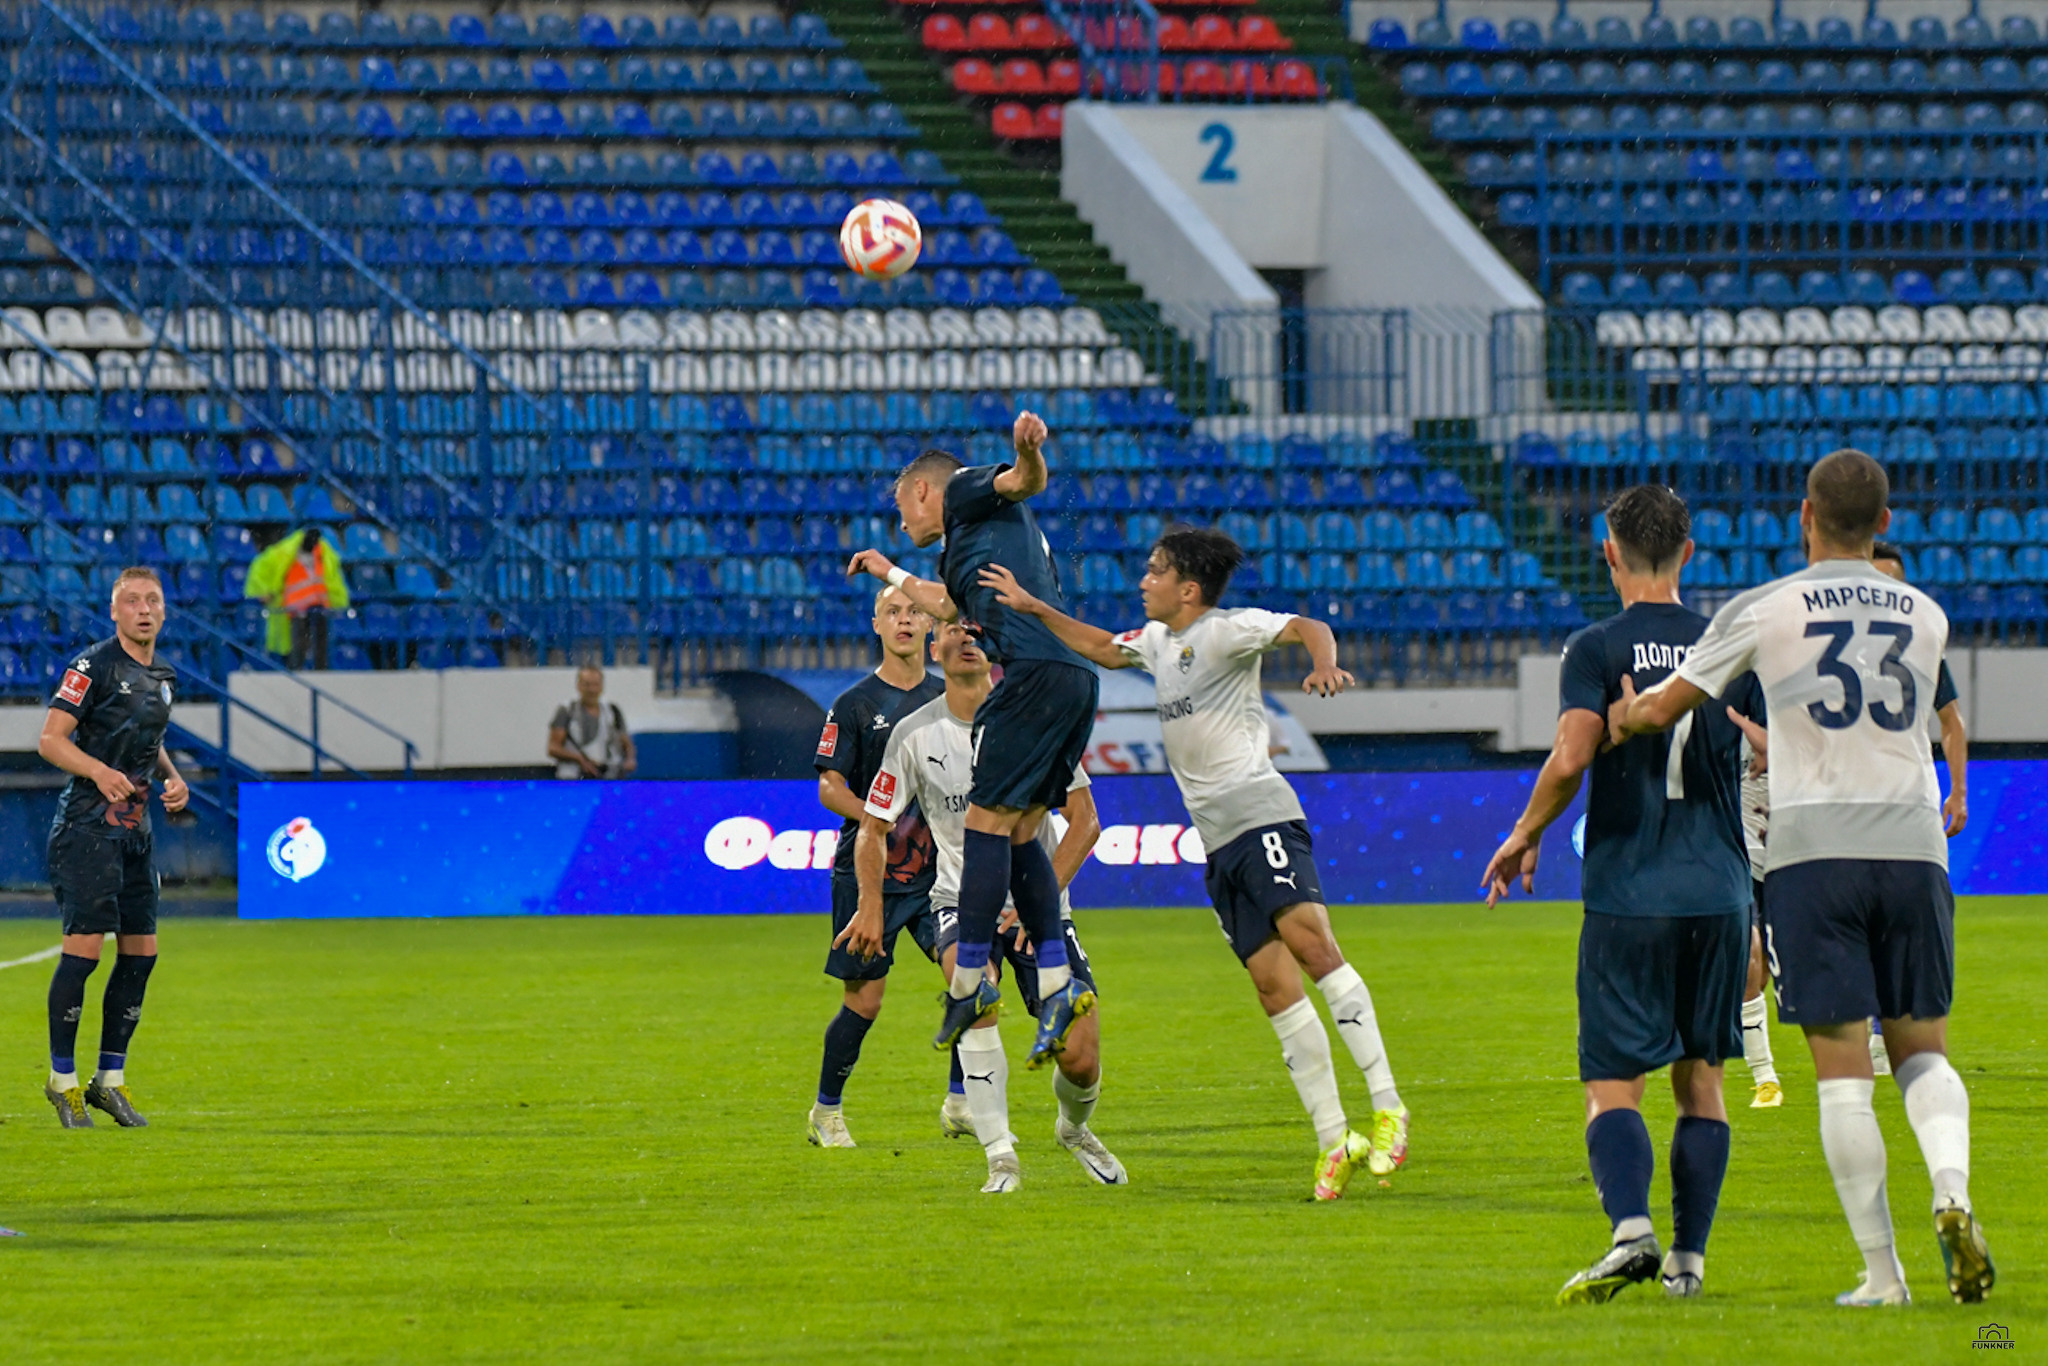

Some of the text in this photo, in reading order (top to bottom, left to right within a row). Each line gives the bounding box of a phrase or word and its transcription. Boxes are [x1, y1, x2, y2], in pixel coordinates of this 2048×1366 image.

[1199, 123, 1237, 182] 2
[1802, 585, 1914, 615] МАРСЕЛО
[1803, 620, 1917, 733] 33
[1261, 831, 1289, 870] 8
